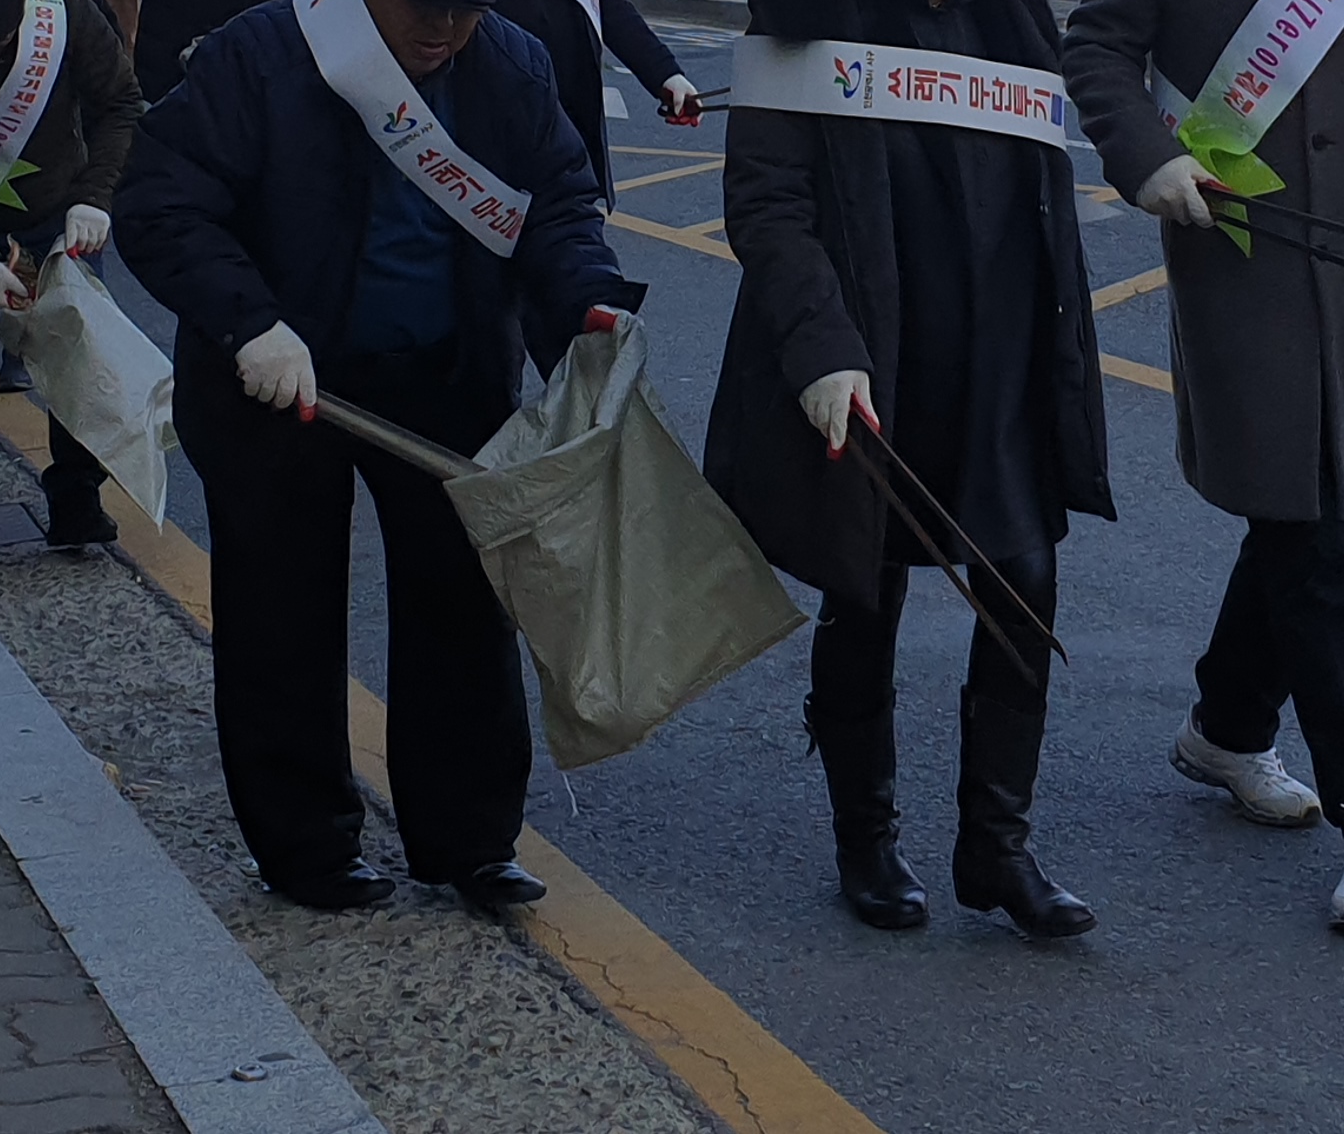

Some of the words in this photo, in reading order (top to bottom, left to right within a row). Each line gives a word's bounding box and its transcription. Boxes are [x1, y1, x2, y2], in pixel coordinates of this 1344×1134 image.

[887, 66, 963, 105] 쓰레기
[969, 76, 1051, 123] 무단투기
[416, 148, 486, 202] 쓰레기
